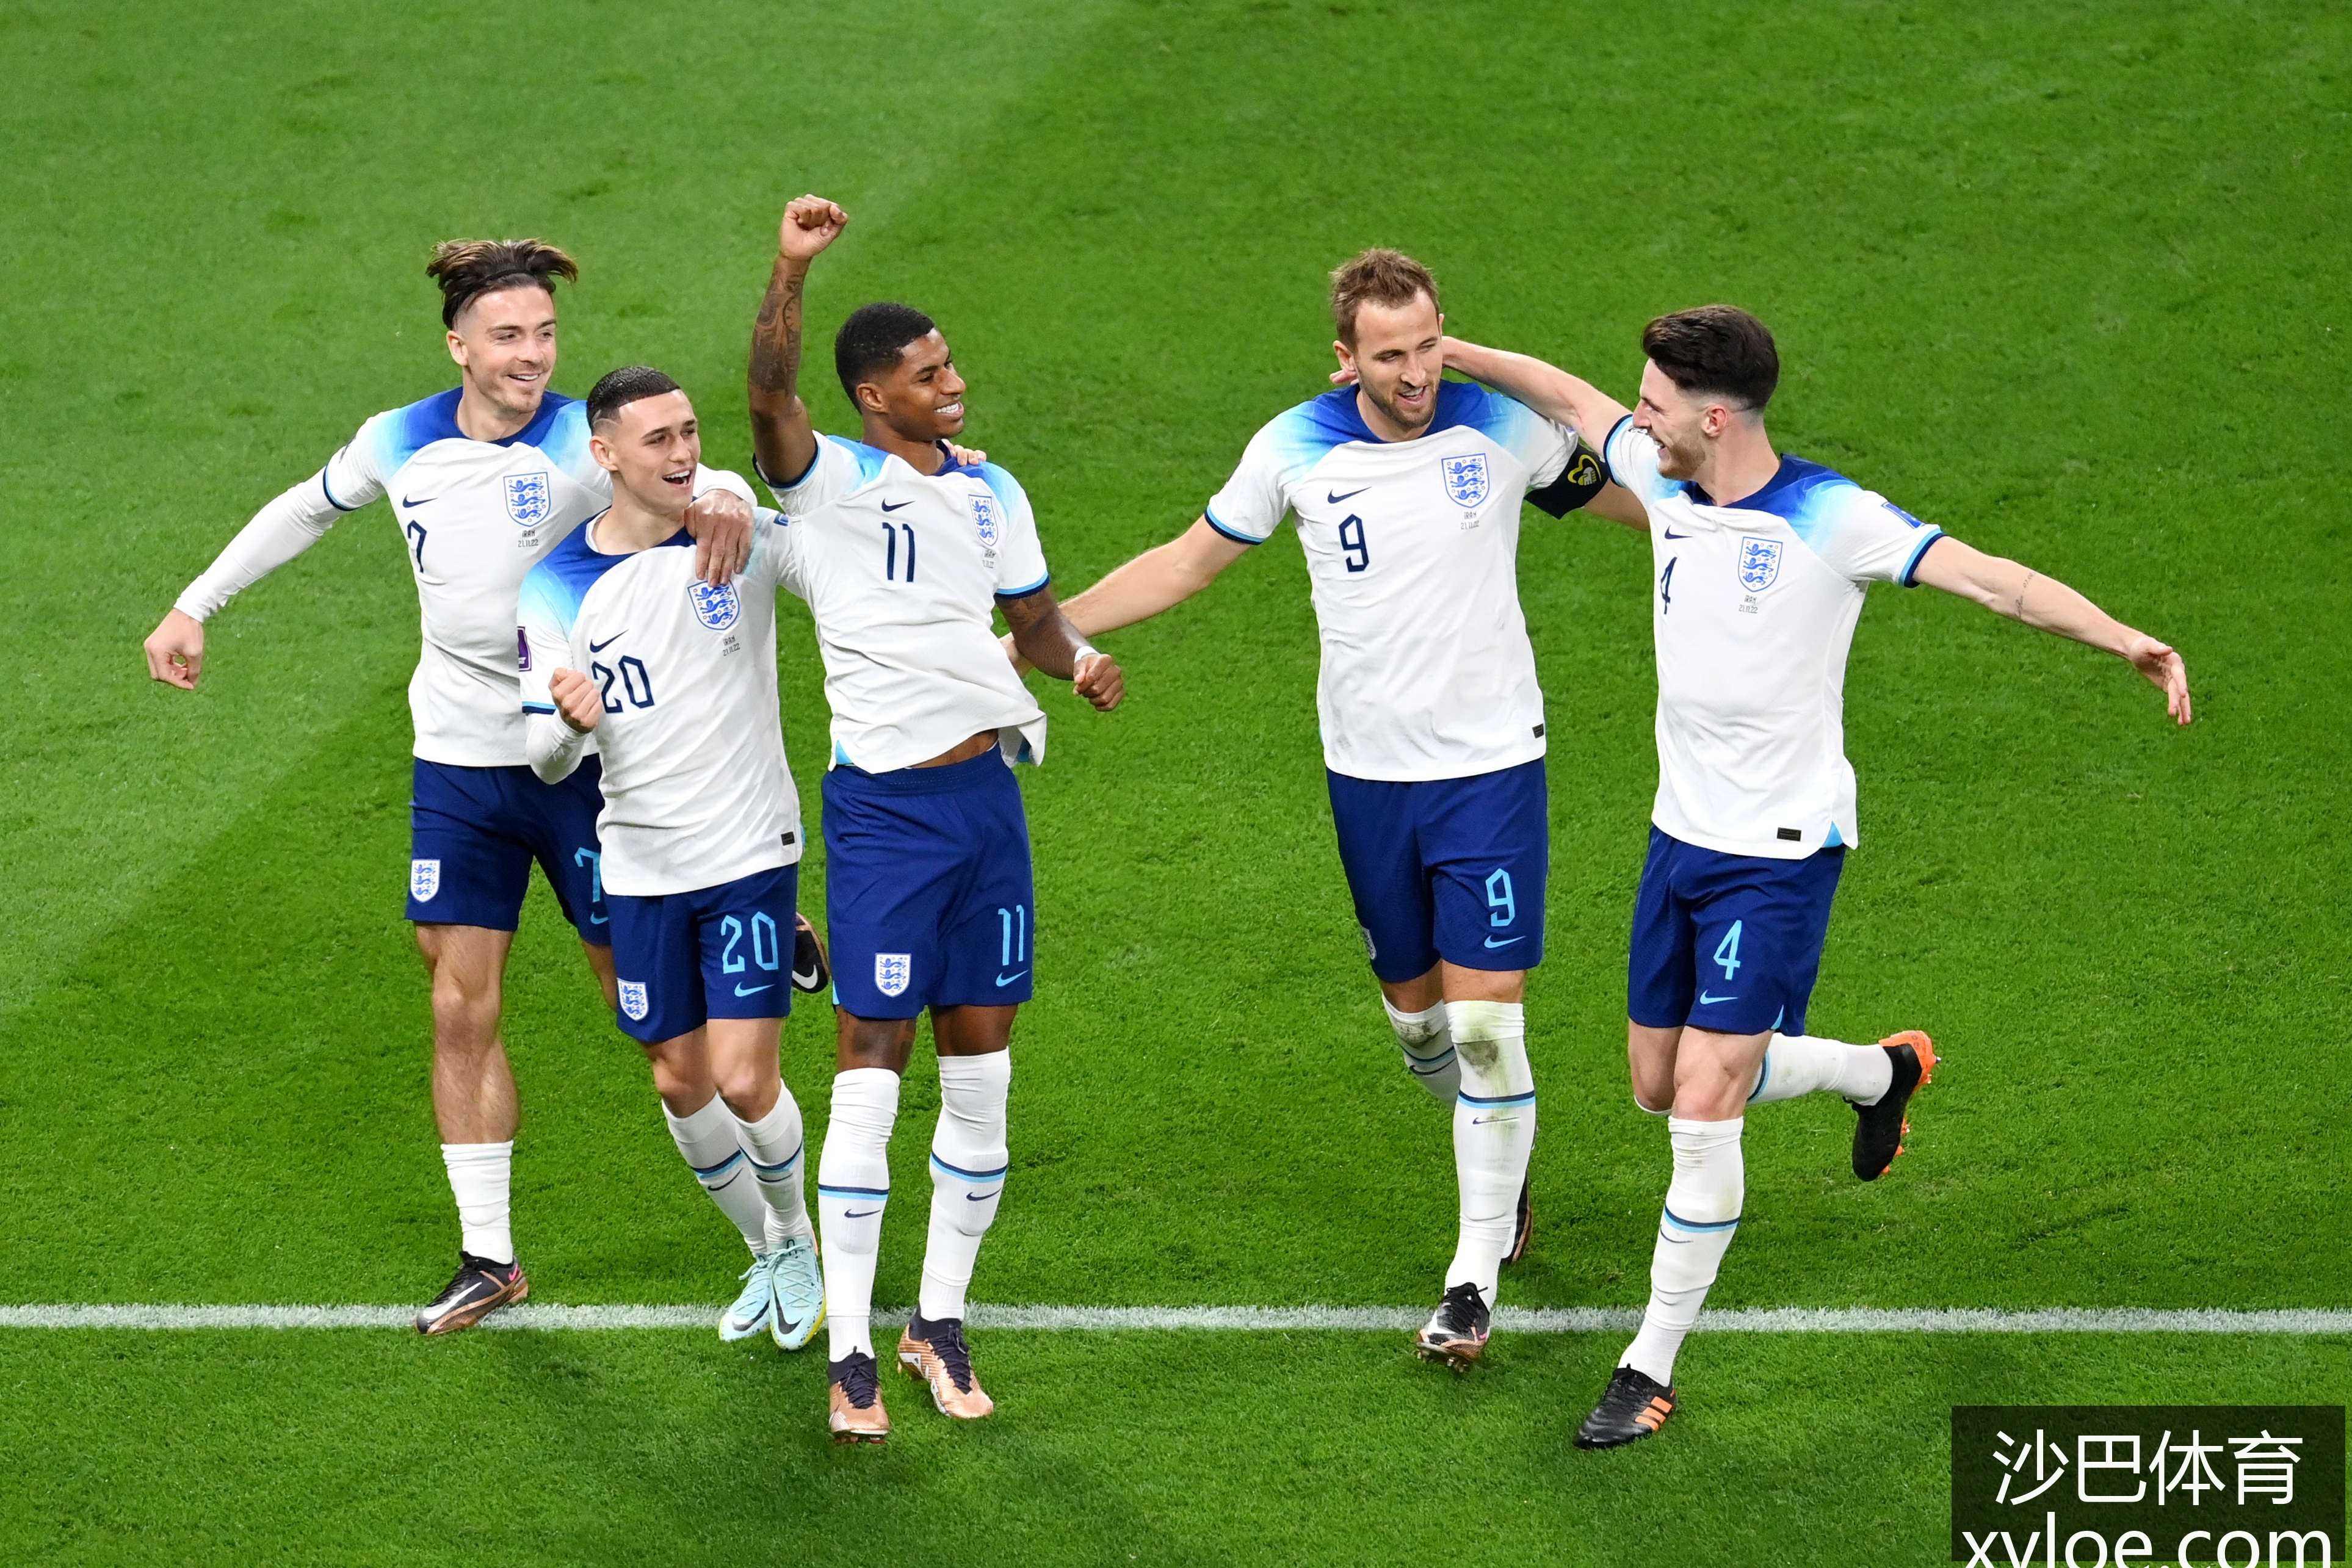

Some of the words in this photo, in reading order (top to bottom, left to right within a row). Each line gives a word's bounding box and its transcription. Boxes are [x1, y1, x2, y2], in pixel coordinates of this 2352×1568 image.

[407, 520, 427, 573] 7
[882, 522, 915, 582] 11
[1339, 515, 1369, 572] 9
[1660, 557, 1677, 615] 4
[591, 655, 654, 714] 20
[574, 847, 601, 903] 7
[1486, 868, 1515, 927] 9
[720, 911, 779, 975] 20
[998, 904, 1024, 966] 11
[1713, 920, 1742, 981] 4
